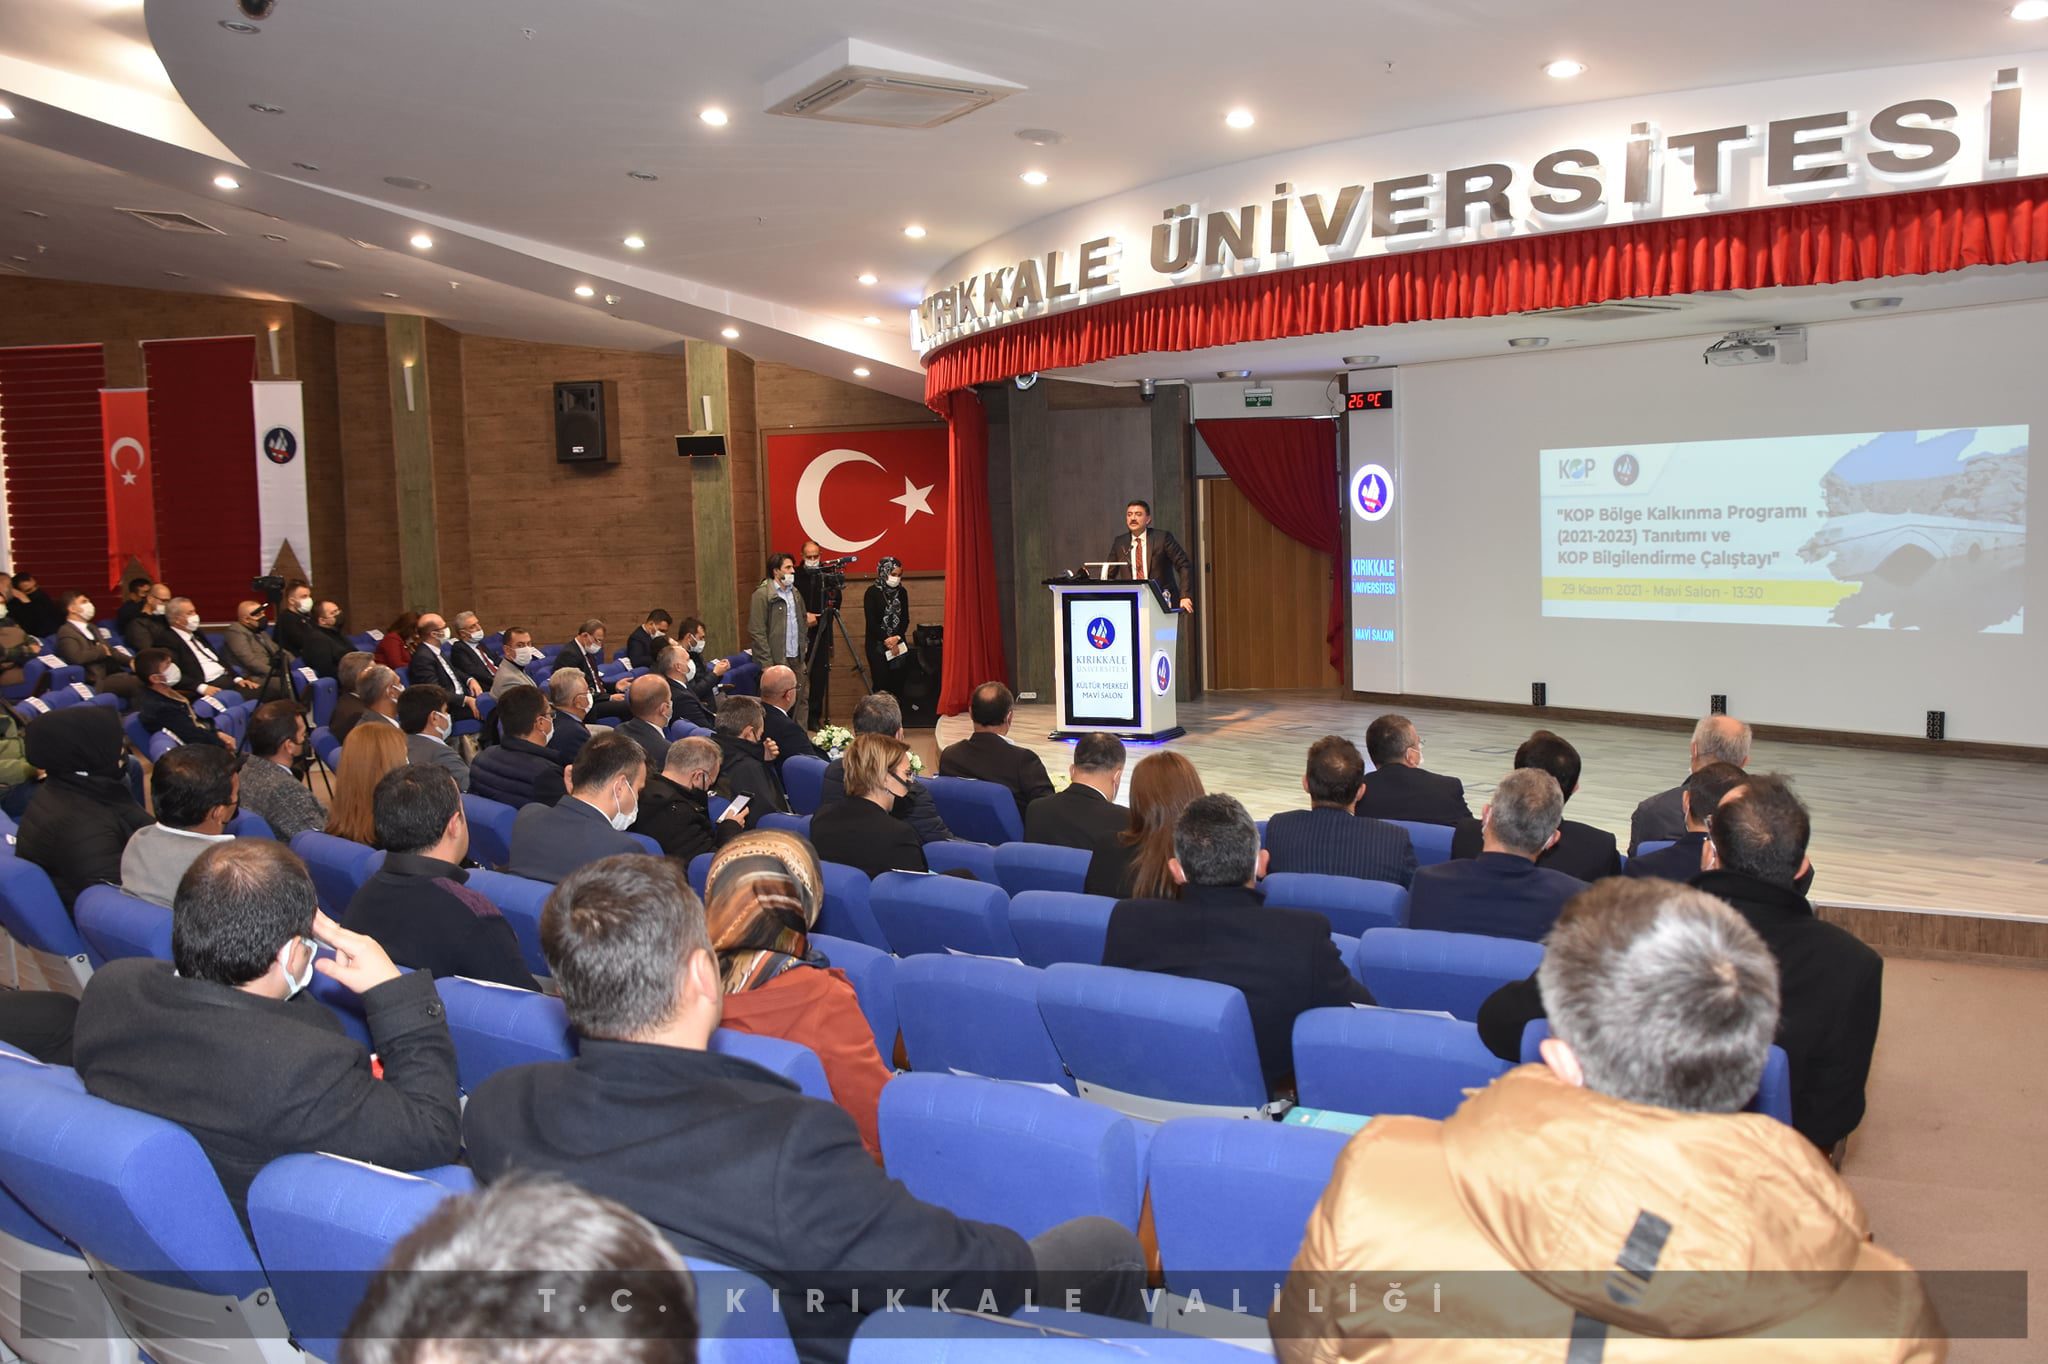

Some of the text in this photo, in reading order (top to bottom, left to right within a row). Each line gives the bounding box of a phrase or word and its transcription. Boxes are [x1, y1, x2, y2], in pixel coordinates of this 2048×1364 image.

[918, 68, 2021, 342] KIRIKKALE ÜNİVERSİTESİ
[1348, 393, 1364, 409] 26
[1559, 458, 1596, 479] KOP
[1557, 505, 1808, 524] "KOP Bölge Kalkınma Programı
[1557, 529, 1731, 546] (2021-2023) Tanıtımı ve
[1352, 559, 1395, 577] KIRIKKALE
[1557, 550, 1780, 569] KOP Bilgilendirme Çalıştayı"
[1561, 583, 1576, 595] 29
[1578, 584, 1614, 596] Kasım
[1616, 584, 1643, 597] 2021
[1653, 585, 1682, 597] Mavi
[1685, 585, 1721, 599] Salon
[1732, 586, 1764, 600] 13:30
[1371, 629, 1394, 643] SALON
[1076, 655, 1127, 664] KIRIKKALE
[1101, 691, 1123, 699] SALON
